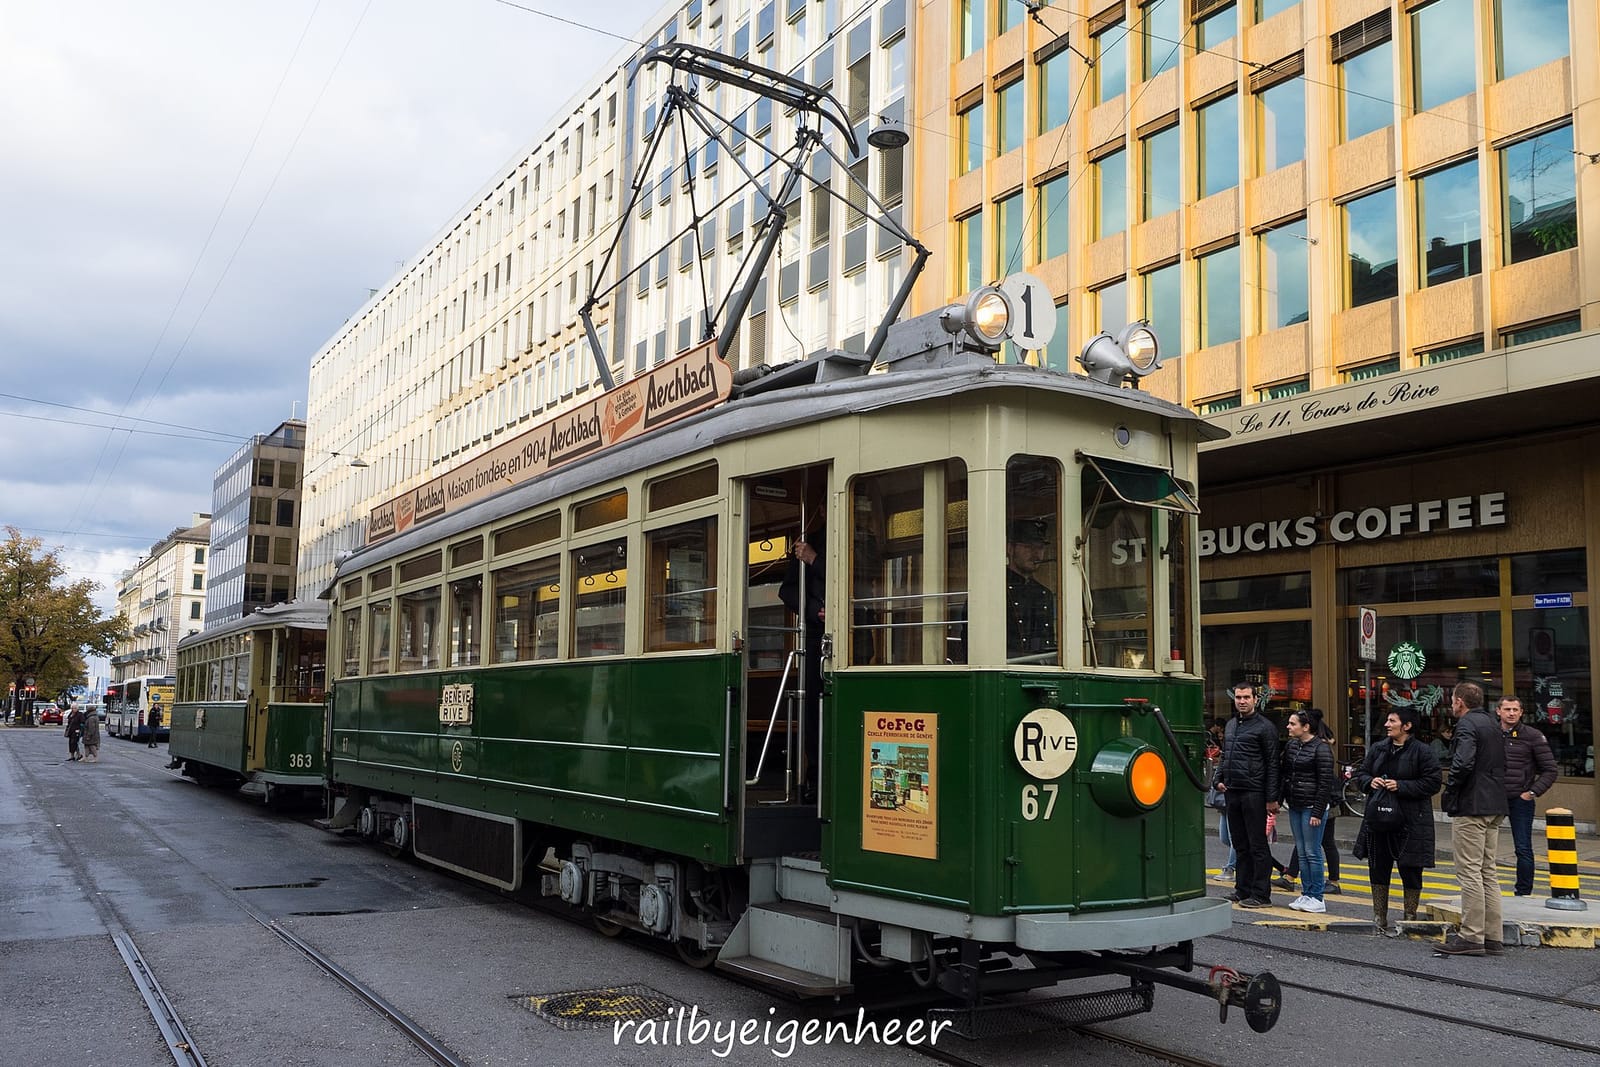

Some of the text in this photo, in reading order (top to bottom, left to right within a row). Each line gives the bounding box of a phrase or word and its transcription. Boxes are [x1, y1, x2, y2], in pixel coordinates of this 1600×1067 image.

[1021, 285, 1035, 339] 1
[645, 347, 718, 424] Aeschbach
[1236, 412, 1263, 435] Le
[1301, 400, 1352, 422] Cours
[1356, 391, 1378, 411] de
[1382, 382, 1440, 406] Rive
[446, 476, 474, 503] Maison
[475, 457, 507, 491] fondée
[508, 454, 521, 475] en
[521, 436, 547, 469] 1904
[548, 402, 602, 461] Aeschbach
[1329, 492, 1506, 543] COFFEE
[443, 707, 464, 721] RIVE
[877, 717, 926, 732] CeFeG
[289, 753, 313, 769] 363
[1021, 783, 1059, 821] 67
